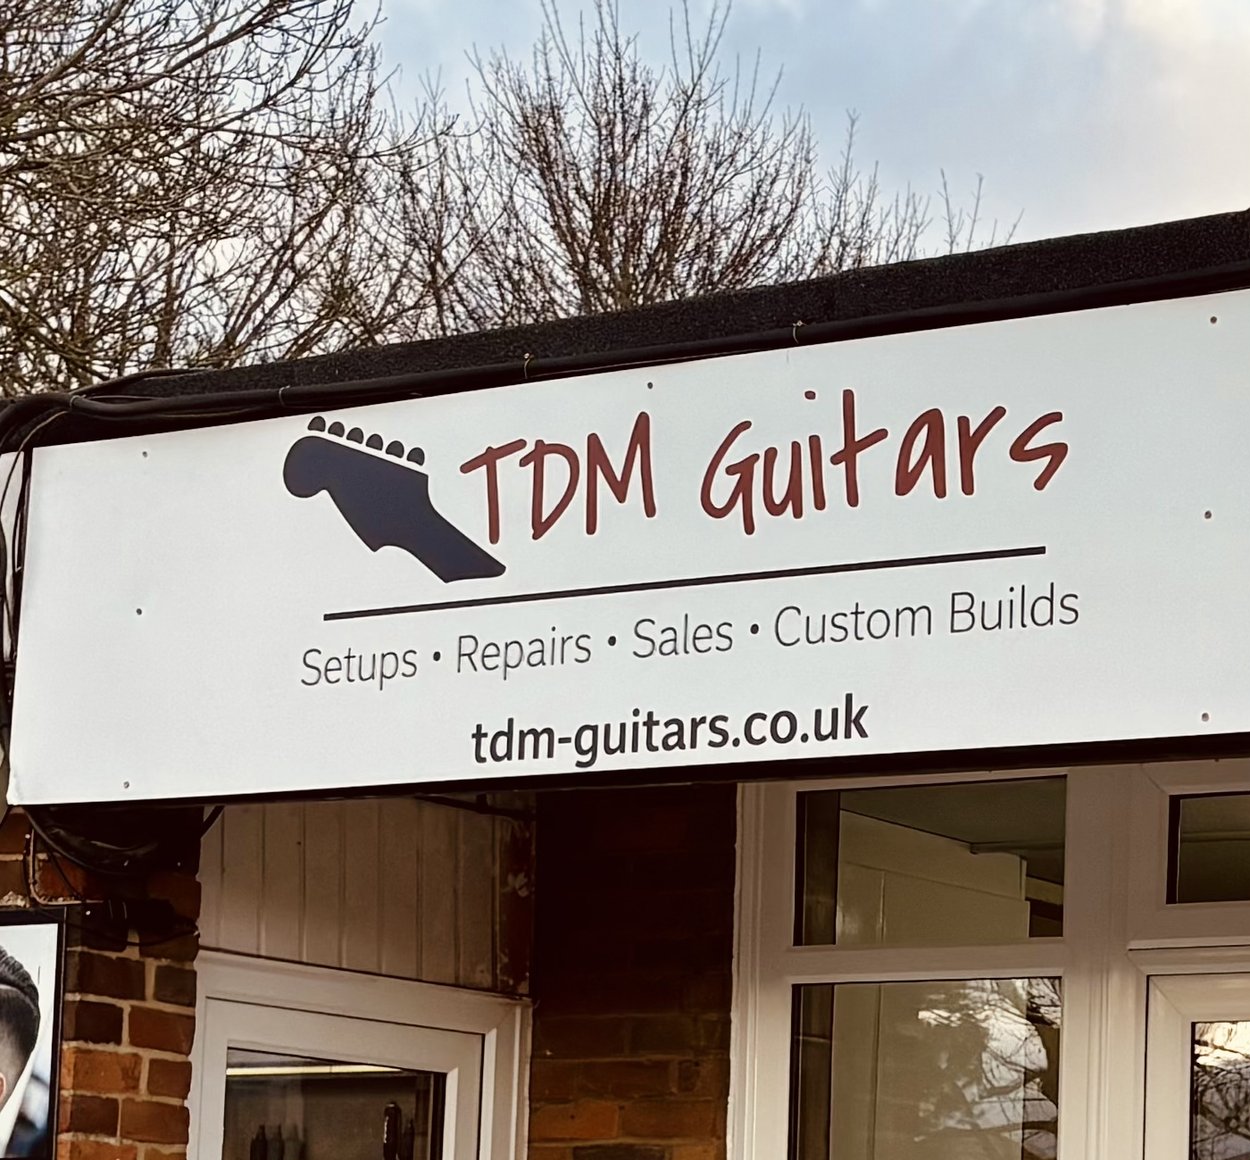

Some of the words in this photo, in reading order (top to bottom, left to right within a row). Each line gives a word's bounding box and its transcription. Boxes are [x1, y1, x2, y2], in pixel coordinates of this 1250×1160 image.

[461, 412, 656, 544] TDM
[700, 389, 1069, 535] Guitars
[300, 648, 418, 691] Setups
[456, 626, 592, 681] Repairs
[632, 613, 733, 659] Sales
[774, 602, 932, 648] Custom
[950, 581, 1080, 634] Builds
[472, 694, 869, 768] tdm-guitars.co.uk
